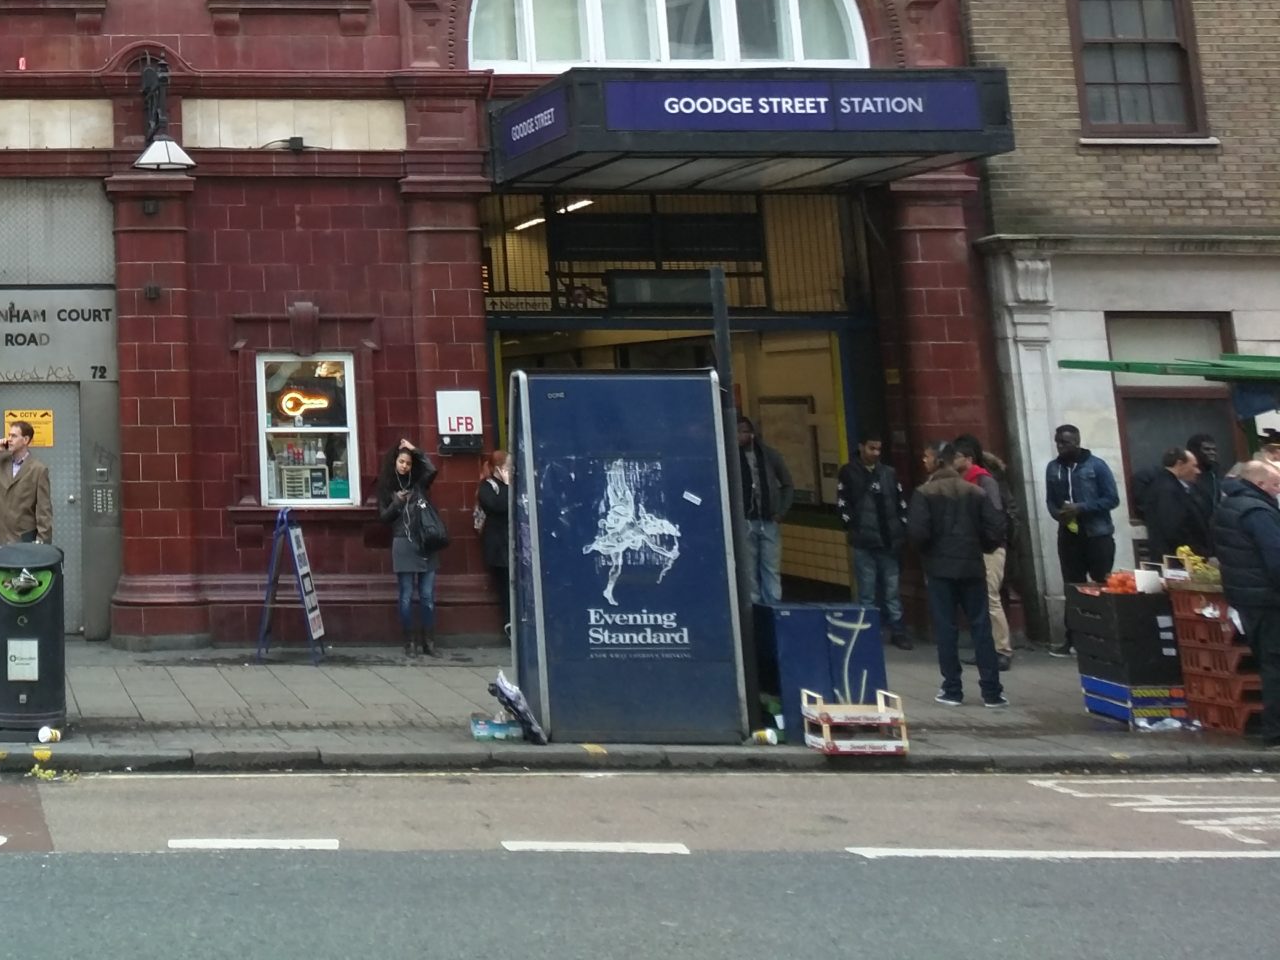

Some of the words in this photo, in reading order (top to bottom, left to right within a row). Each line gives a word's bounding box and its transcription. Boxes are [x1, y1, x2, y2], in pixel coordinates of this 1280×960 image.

[664, 97, 754, 113] GOODGE
[758, 97, 829, 113] STREET
[840, 97, 924, 113] STATION
[511, 117, 535, 141] GOODGE
[534, 107, 555, 131] STREET
[500, 300, 549, 310] Northern
[56, 308, 113, 322] COURT
[4, 333, 51, 347] ROAD
[90, 365, 108, 380] 72
[447, 416, 475, 432] LFB
[586, 608, 678, 629] Evening
[588, 627, 691, 645] Standard
